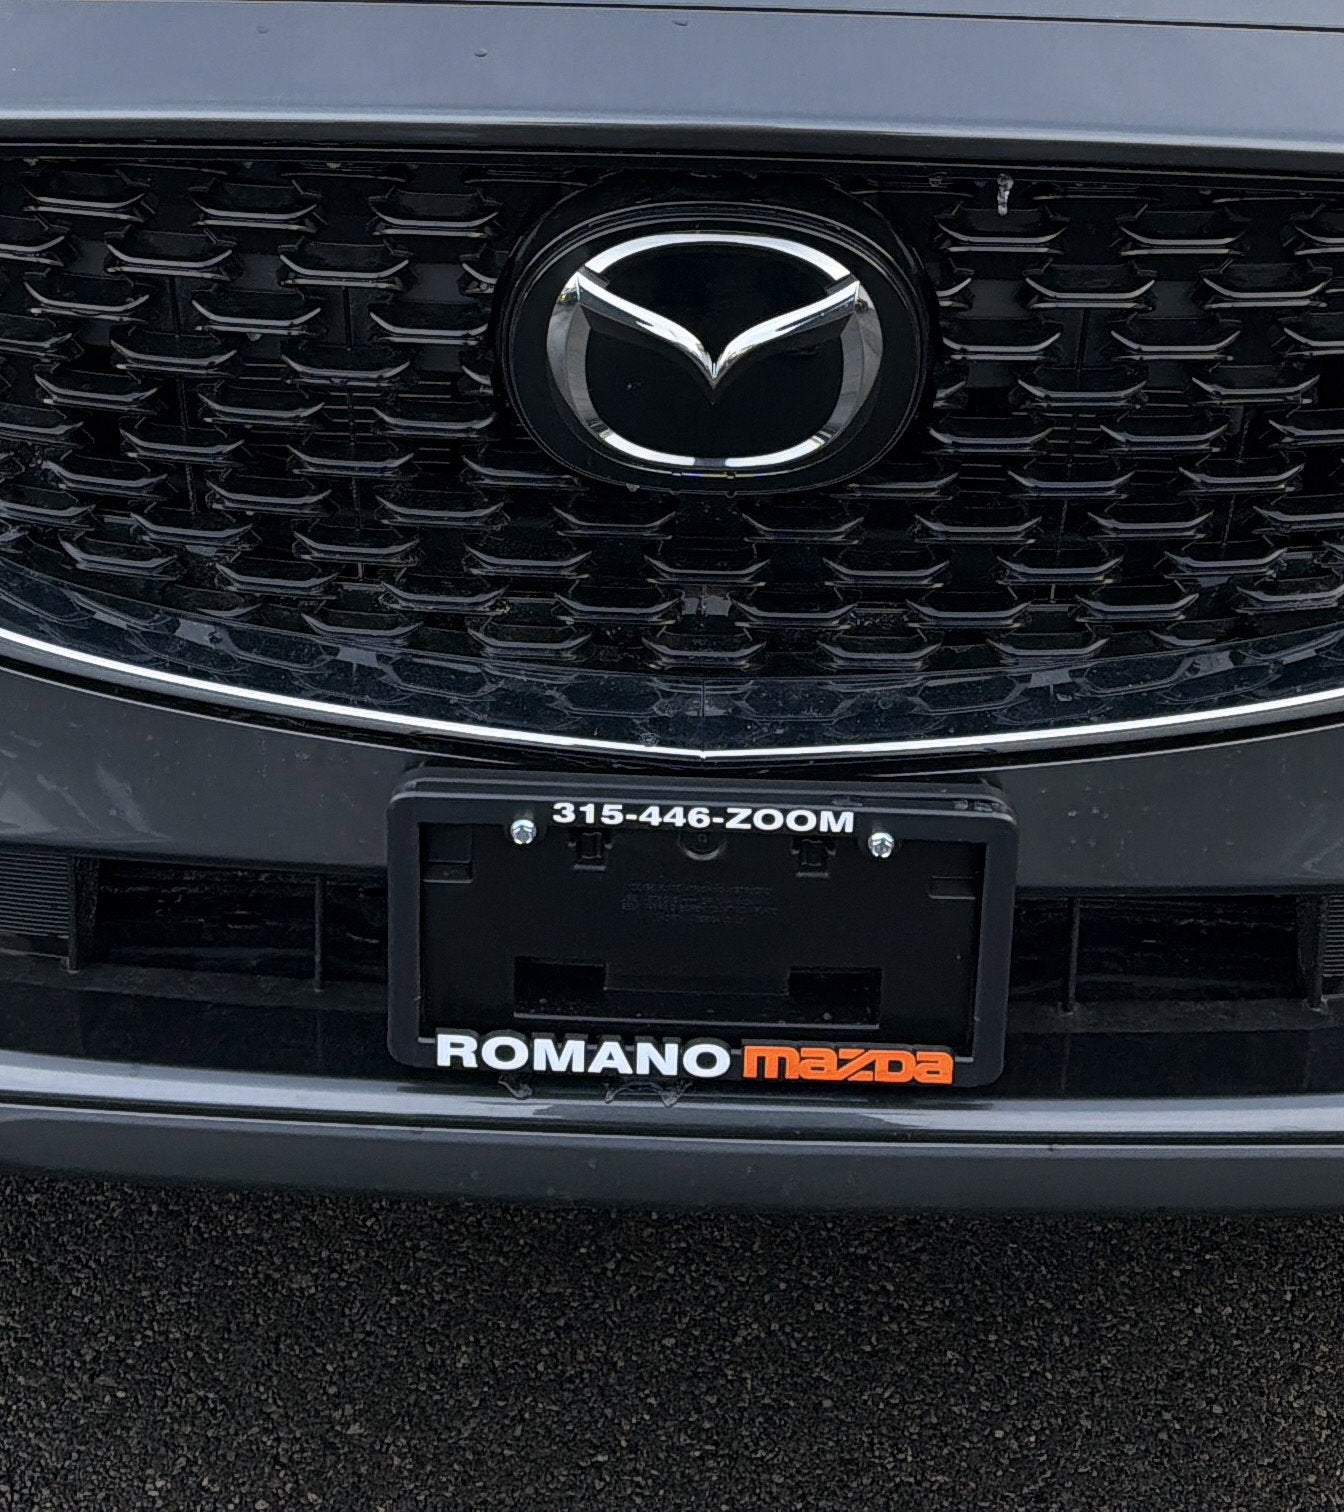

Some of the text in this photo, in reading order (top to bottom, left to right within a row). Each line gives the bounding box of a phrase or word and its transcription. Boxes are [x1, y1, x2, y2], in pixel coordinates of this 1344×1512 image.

[552, 800, 855, 833] 315-446-ZOOM
[436, 1034, 954, 1085] ROMANO mazda
